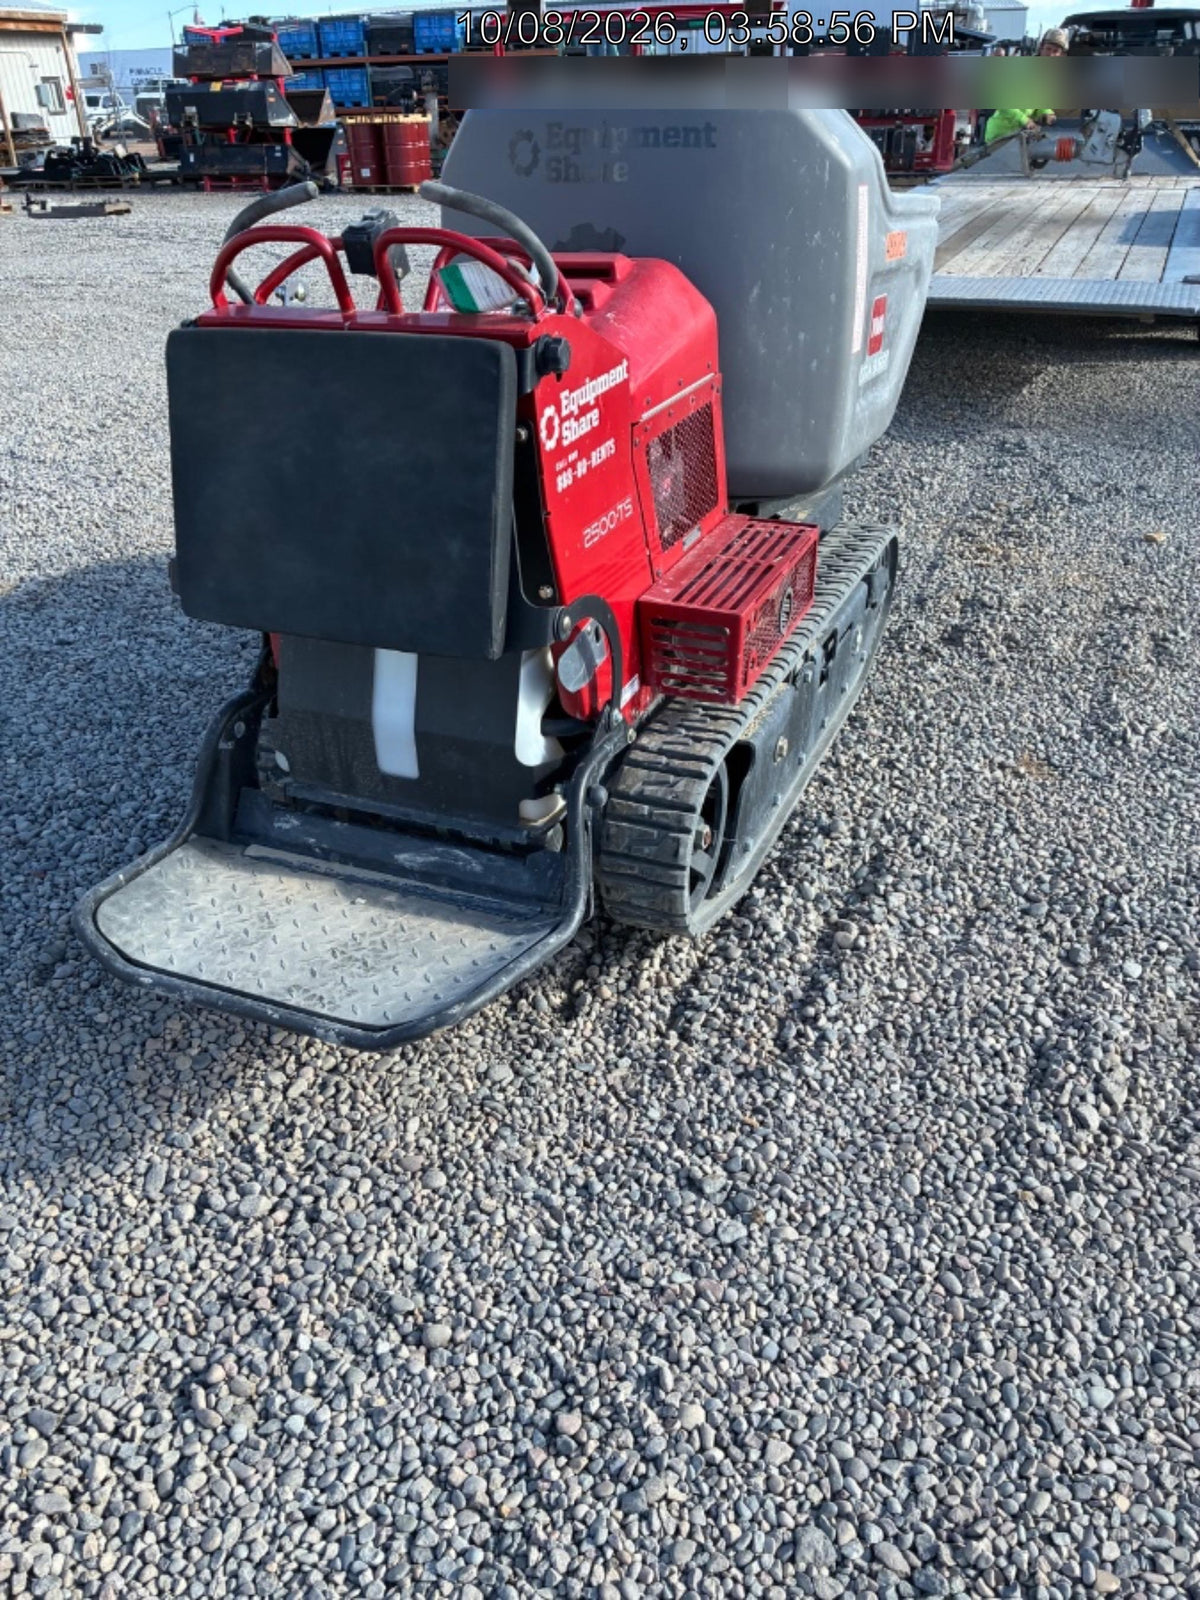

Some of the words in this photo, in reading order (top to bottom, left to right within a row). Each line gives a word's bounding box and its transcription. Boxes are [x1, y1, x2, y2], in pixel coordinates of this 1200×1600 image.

[546, 156, 629, 183] Shre
[560, 358, 629, 418] Equipment
[562, 408, 600, 447] Share
